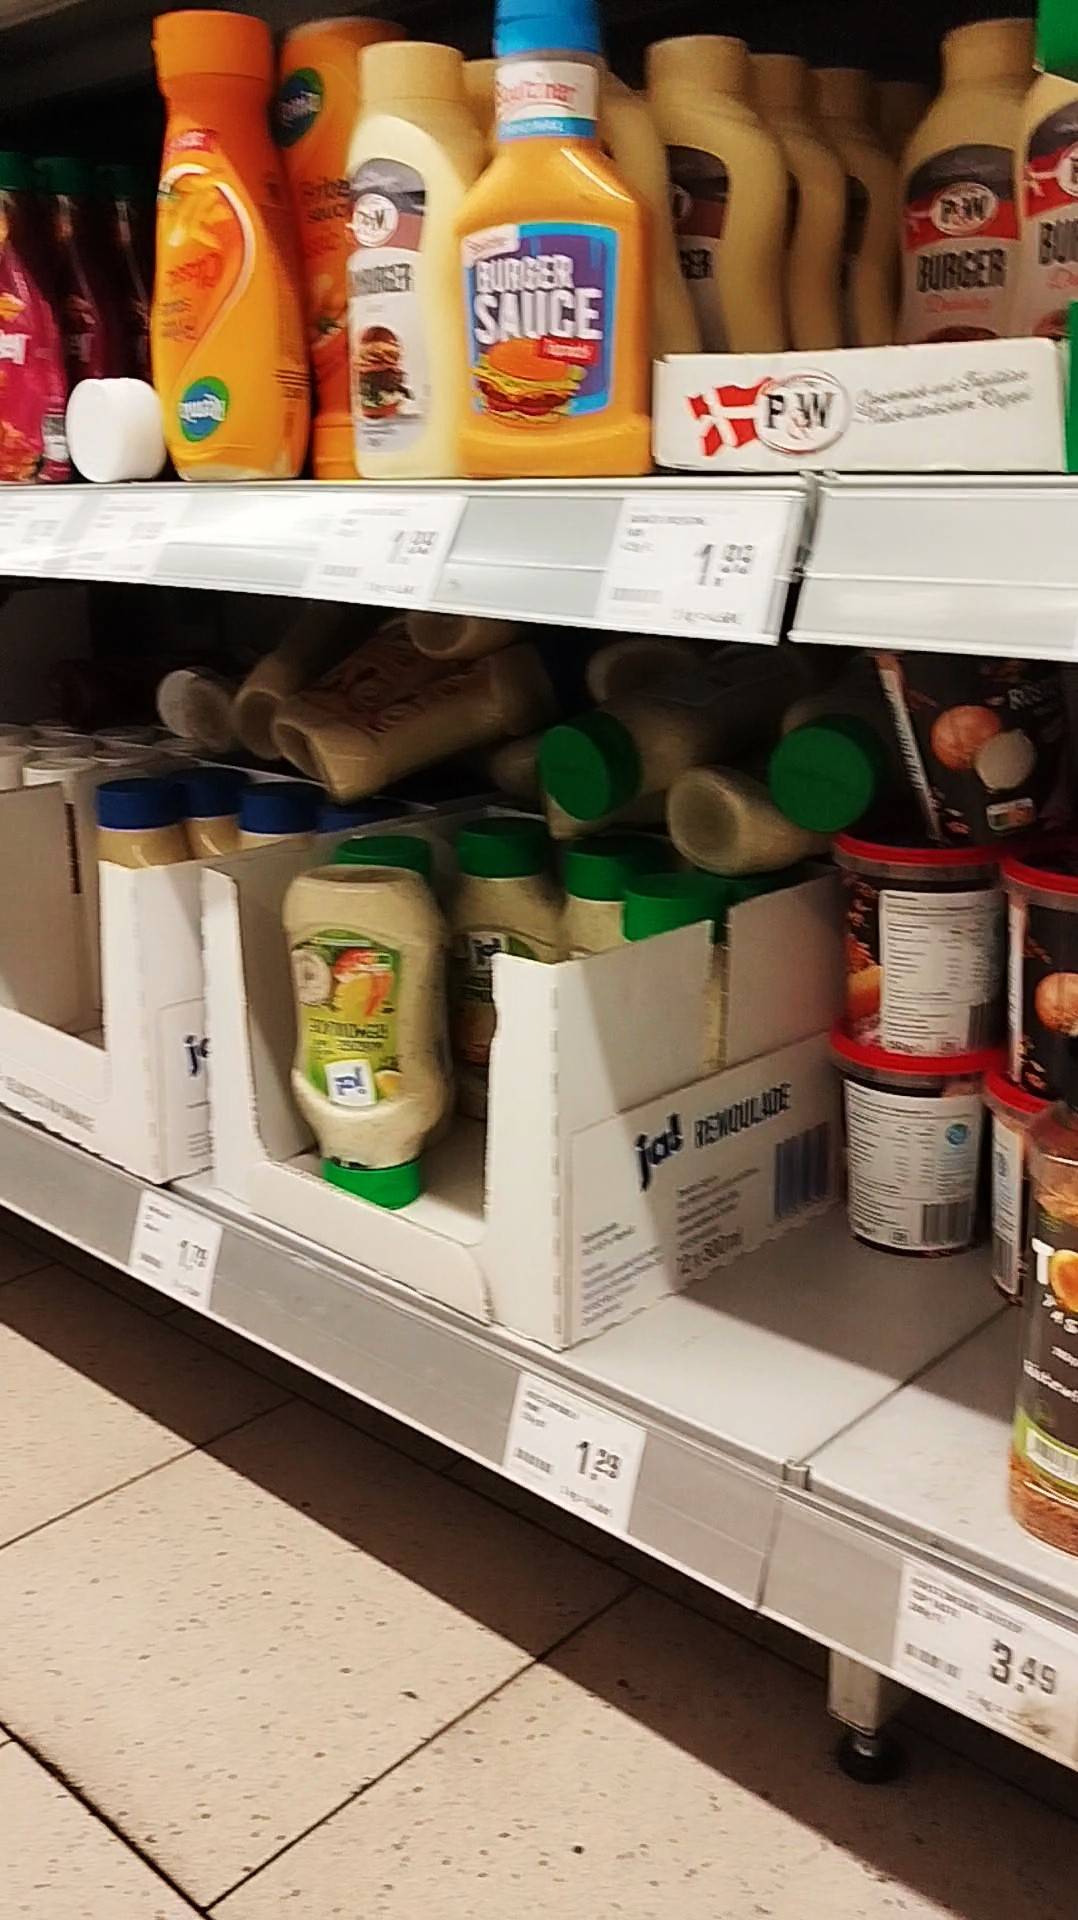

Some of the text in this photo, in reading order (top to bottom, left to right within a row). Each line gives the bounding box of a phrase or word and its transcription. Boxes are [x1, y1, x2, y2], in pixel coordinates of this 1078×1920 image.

[475, 254, 575, 294] BURGER
[917, 249, 1007, 292] BURGER
[474, 287, 604, 345] SAUCE
[765, 391, 837, 442] P&W
[694, 1082, 792, 1149] REMOULADE
[989, 1637, 1058, 1696] 3.49
